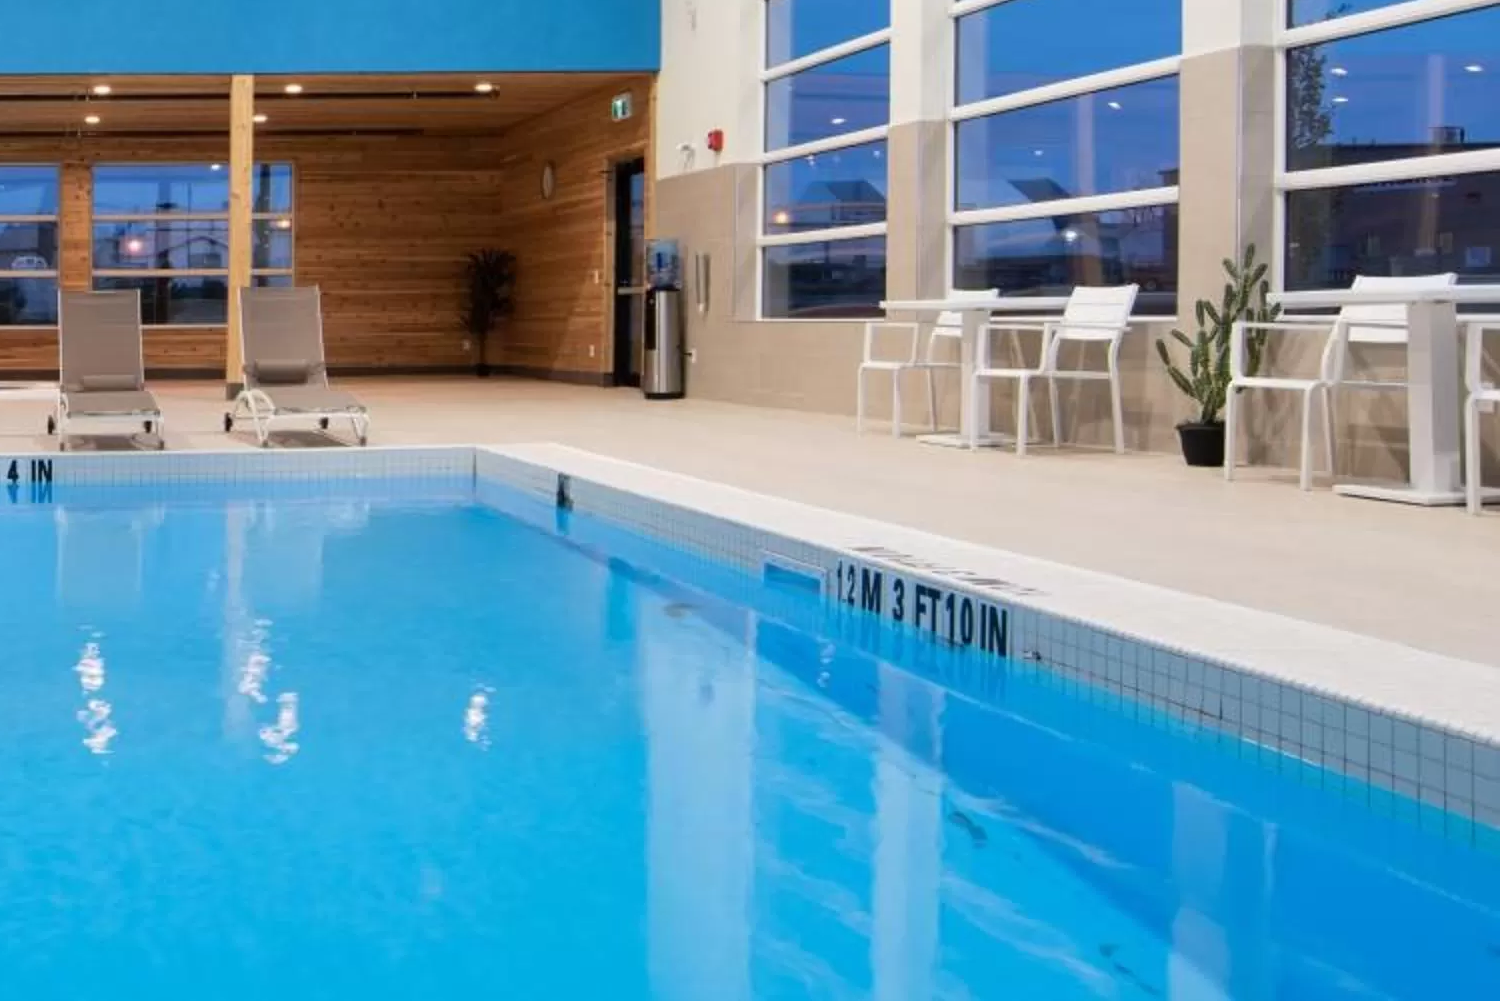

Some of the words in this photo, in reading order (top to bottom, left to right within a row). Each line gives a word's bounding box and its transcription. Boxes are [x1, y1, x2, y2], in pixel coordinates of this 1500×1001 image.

[7, 459, 19, 482] 4
[31, 459, 53, 483] IN
[837, 560, 855, 607] 1.2
[862, 567, 882, 614] M
[892, 579, 905, 621] 3
[915, 583, 941, 632] FT
[946, 593, 973, 646] 10
[980, 603, 1007, 657] IN
